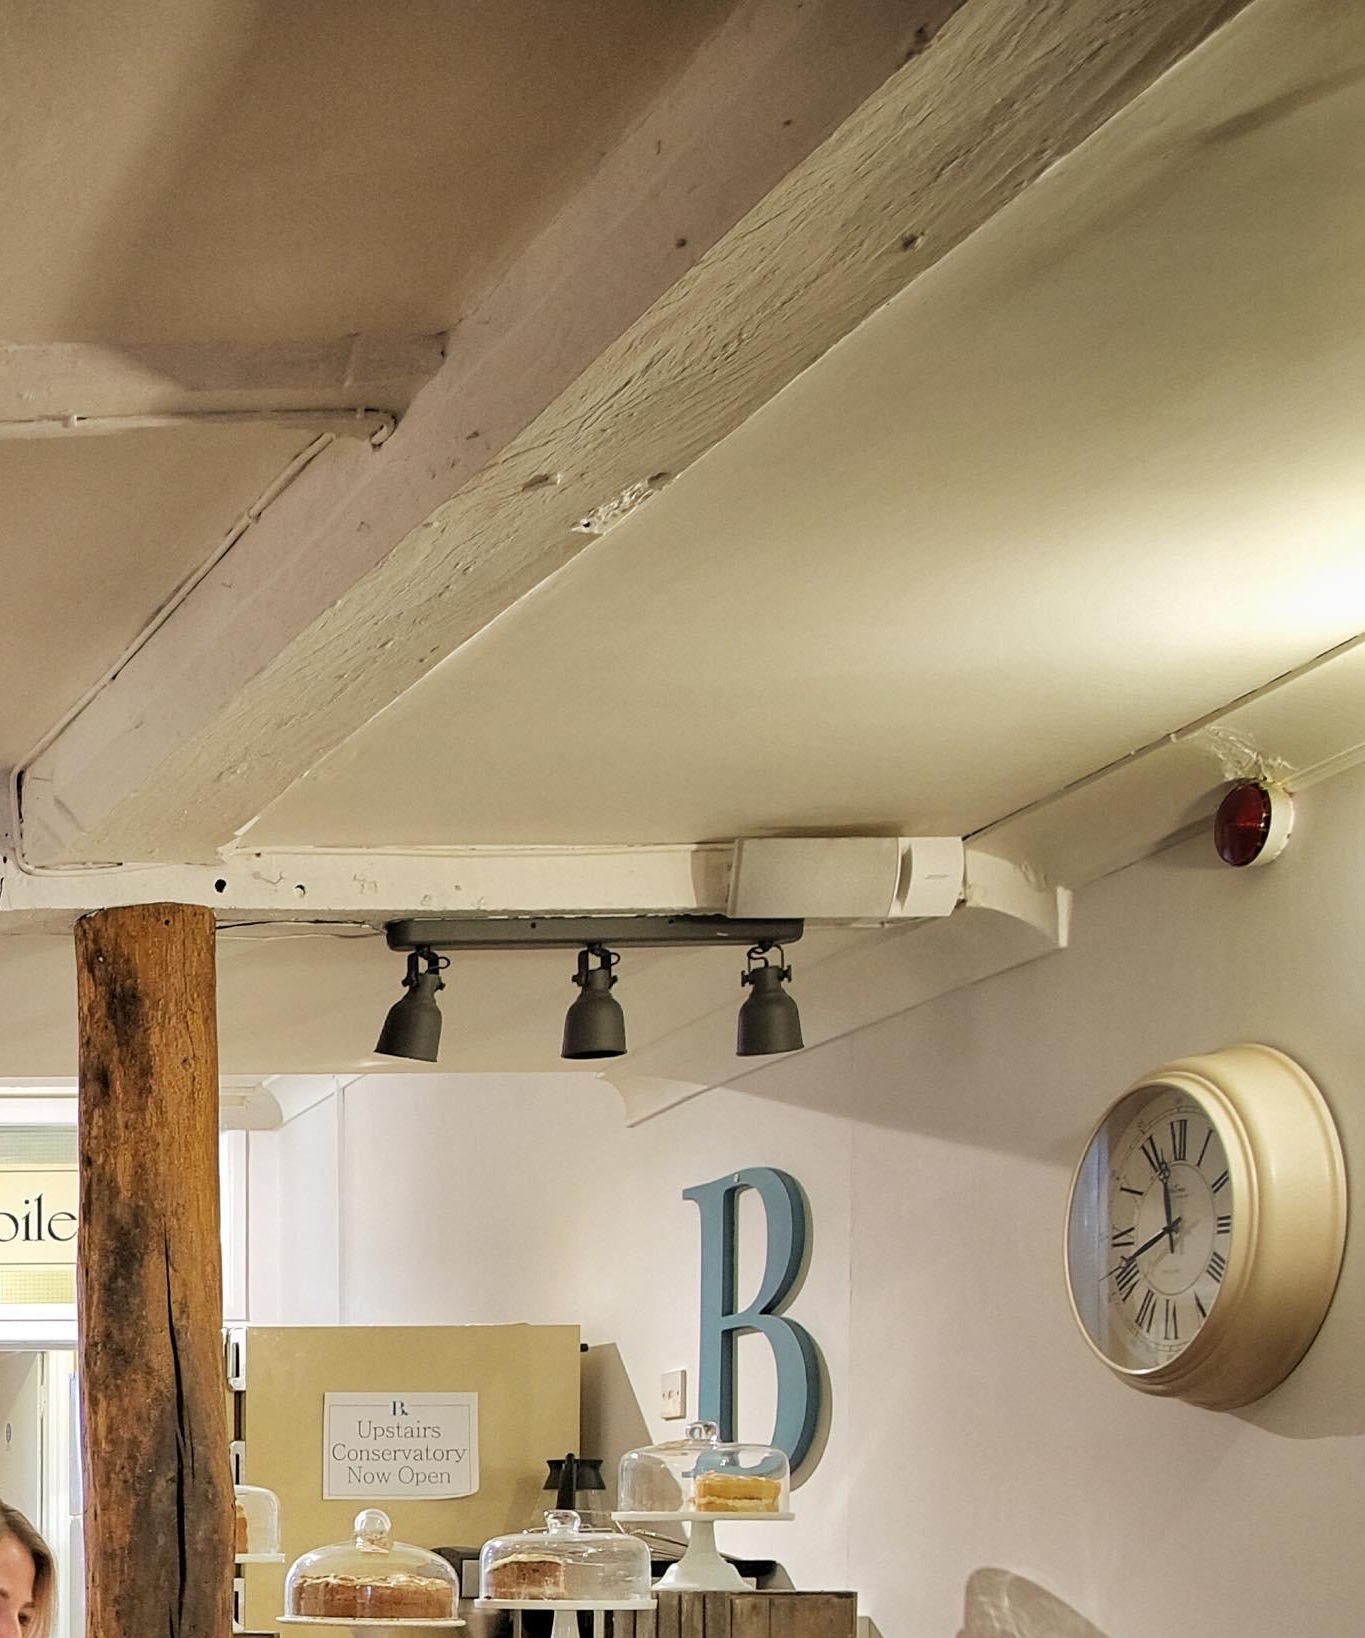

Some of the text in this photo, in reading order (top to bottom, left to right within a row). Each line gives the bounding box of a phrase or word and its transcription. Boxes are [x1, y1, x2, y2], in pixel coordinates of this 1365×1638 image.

[357, 1420, 442, 1441] Upstairs
[331, 1443, 468, 1463] Conservatory
[347, 1465, 452, 1486] Now Open
